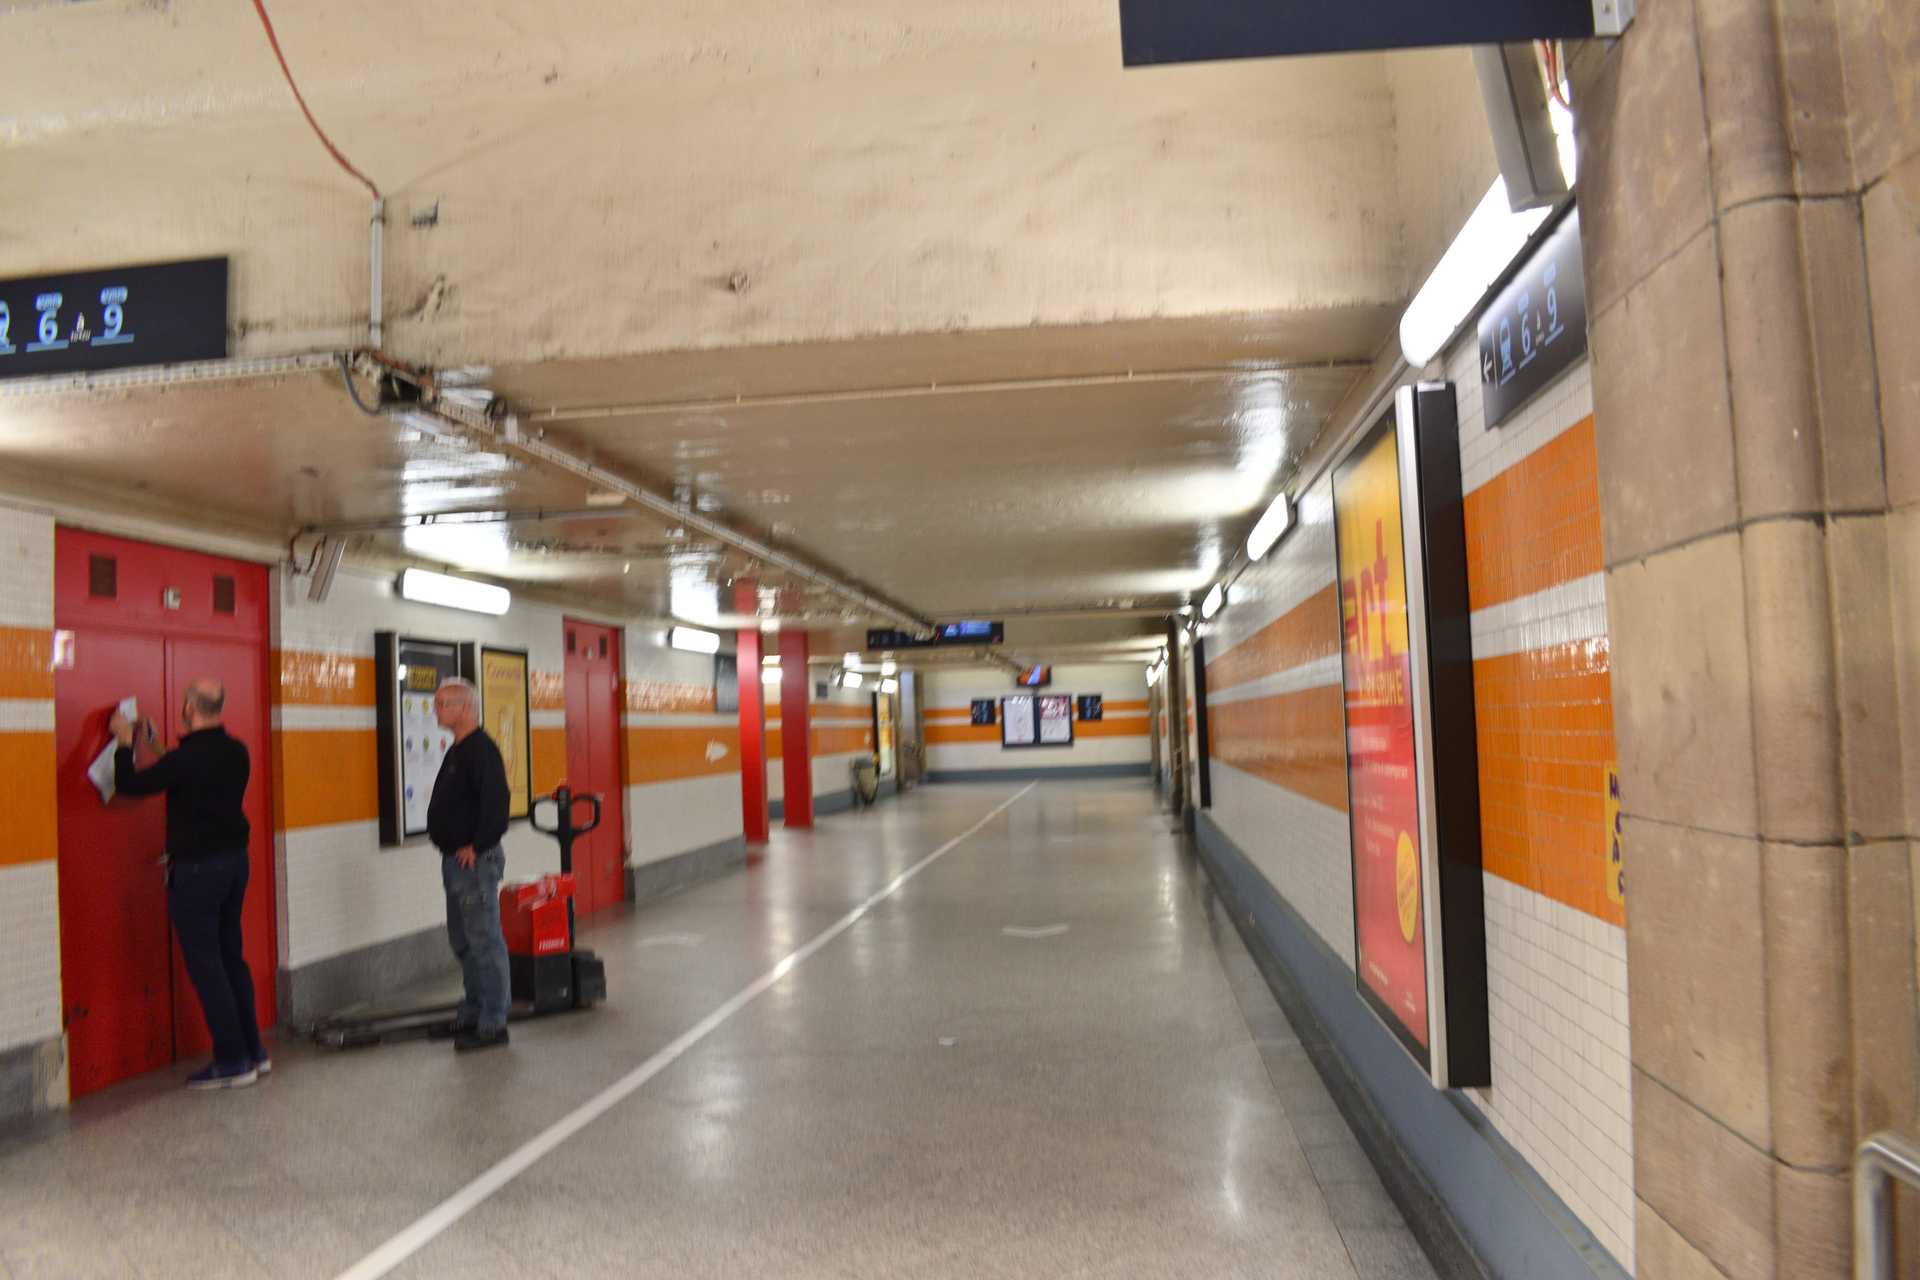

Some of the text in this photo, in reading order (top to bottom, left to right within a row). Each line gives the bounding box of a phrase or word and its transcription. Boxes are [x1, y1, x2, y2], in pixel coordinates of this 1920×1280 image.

[39, 310, 58, 344] 6
[103, 304, 123, 338] 9
[1521, 313, 1531, 354] 6
[1547, 287, 1557, 332] 9
[1343, 518, 1391, 668] art
